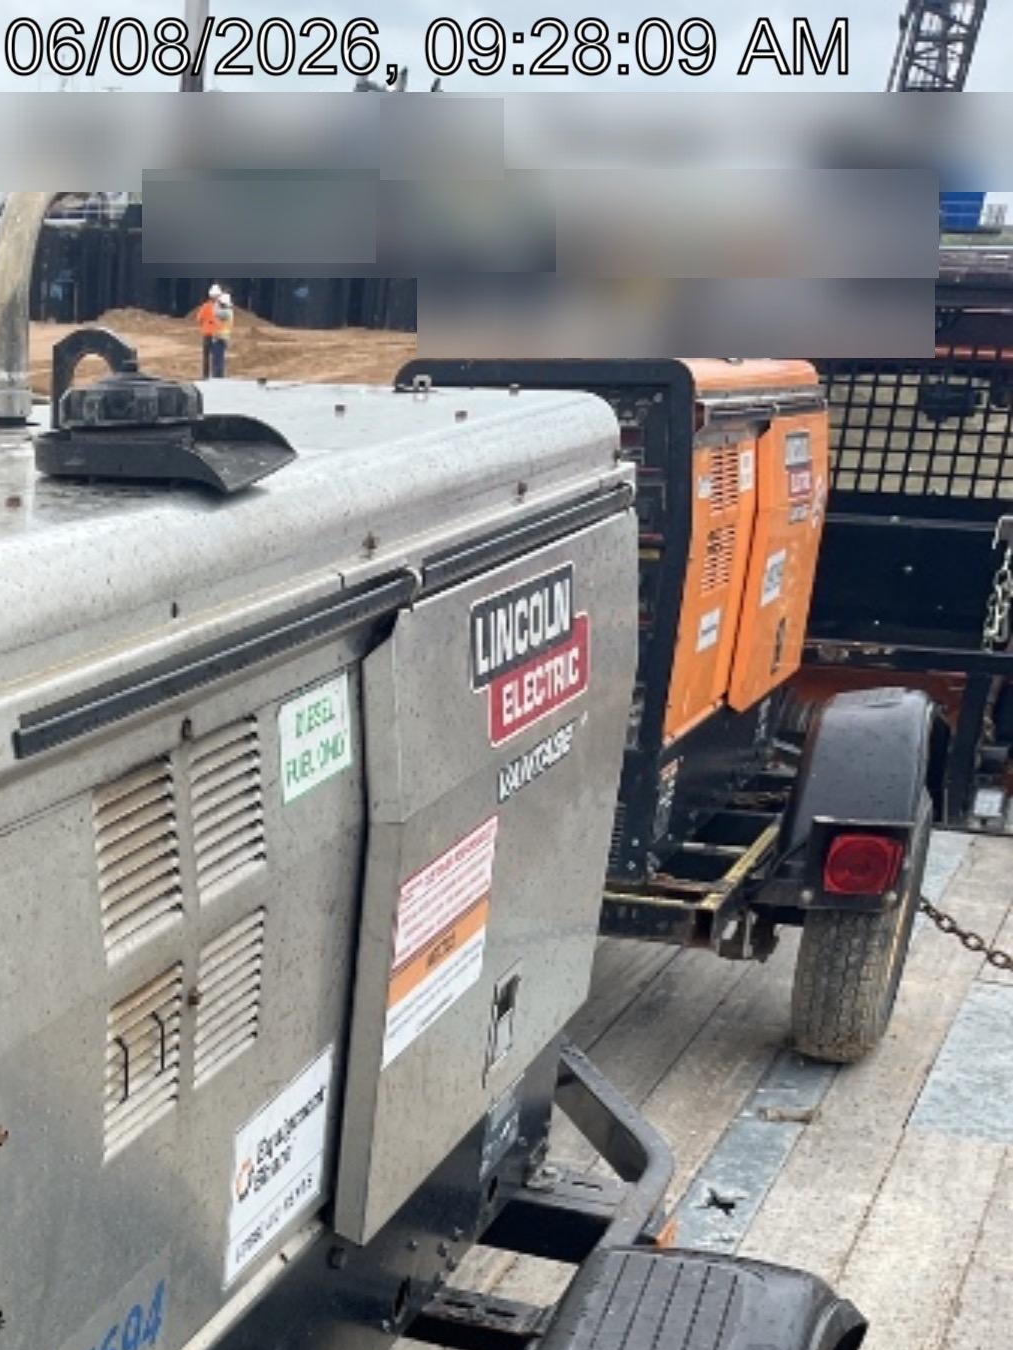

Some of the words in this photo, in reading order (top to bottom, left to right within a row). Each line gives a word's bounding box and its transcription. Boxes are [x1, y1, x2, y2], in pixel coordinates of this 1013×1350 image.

[474, 577, 571, 676] LINCOLN
[294, 694, 335, 738] DIESEL
[501, 645, 580, 728] ELECTRIC
